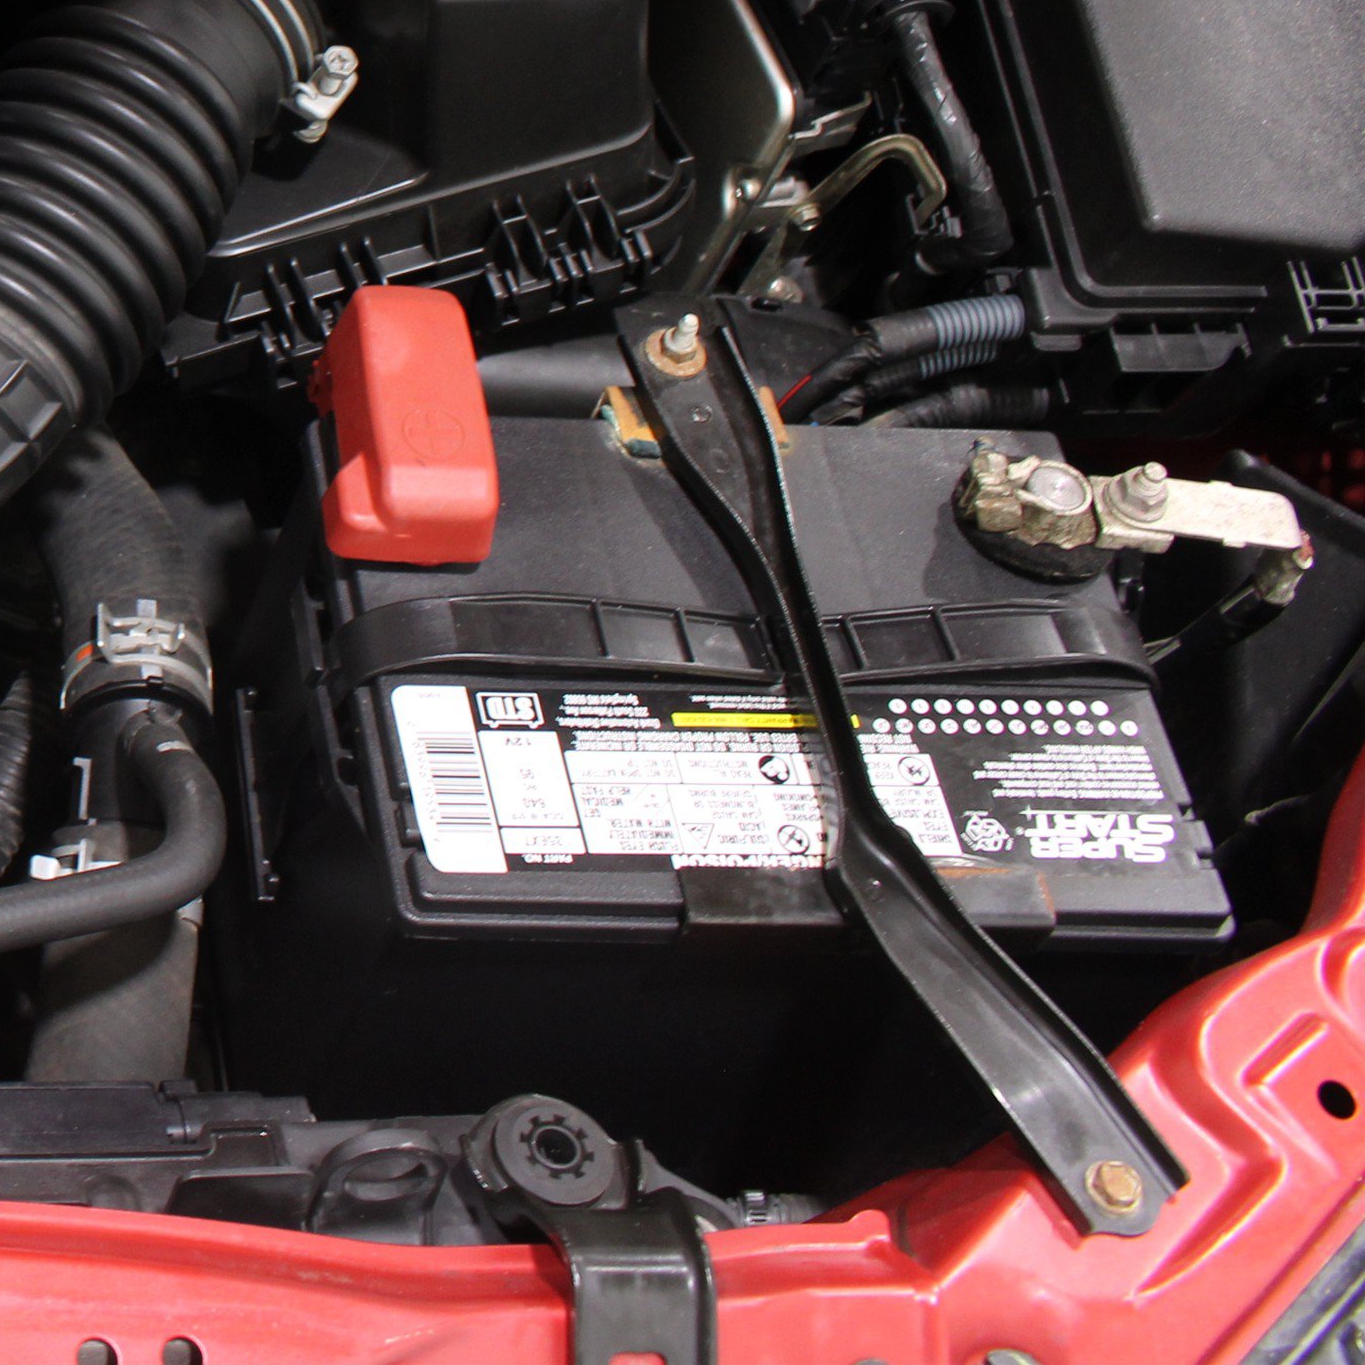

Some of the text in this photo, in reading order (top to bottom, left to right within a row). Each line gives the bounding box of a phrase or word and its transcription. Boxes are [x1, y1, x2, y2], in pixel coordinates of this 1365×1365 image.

[485, 696, 535, 721] STD
[505, 738, 532, 746] 12V
[522, 798, 545, 808] 640
[581, 797, 623, 805] MEDICAL
[1024, 813, 1174, 843] START
[609, 830, 674, 839] IMMEDIATELY
[620, 841, 644, 850] EYES
[1030, 837, 1166, 862] SUPER
[521, 854, 573, 863] PART NO.
